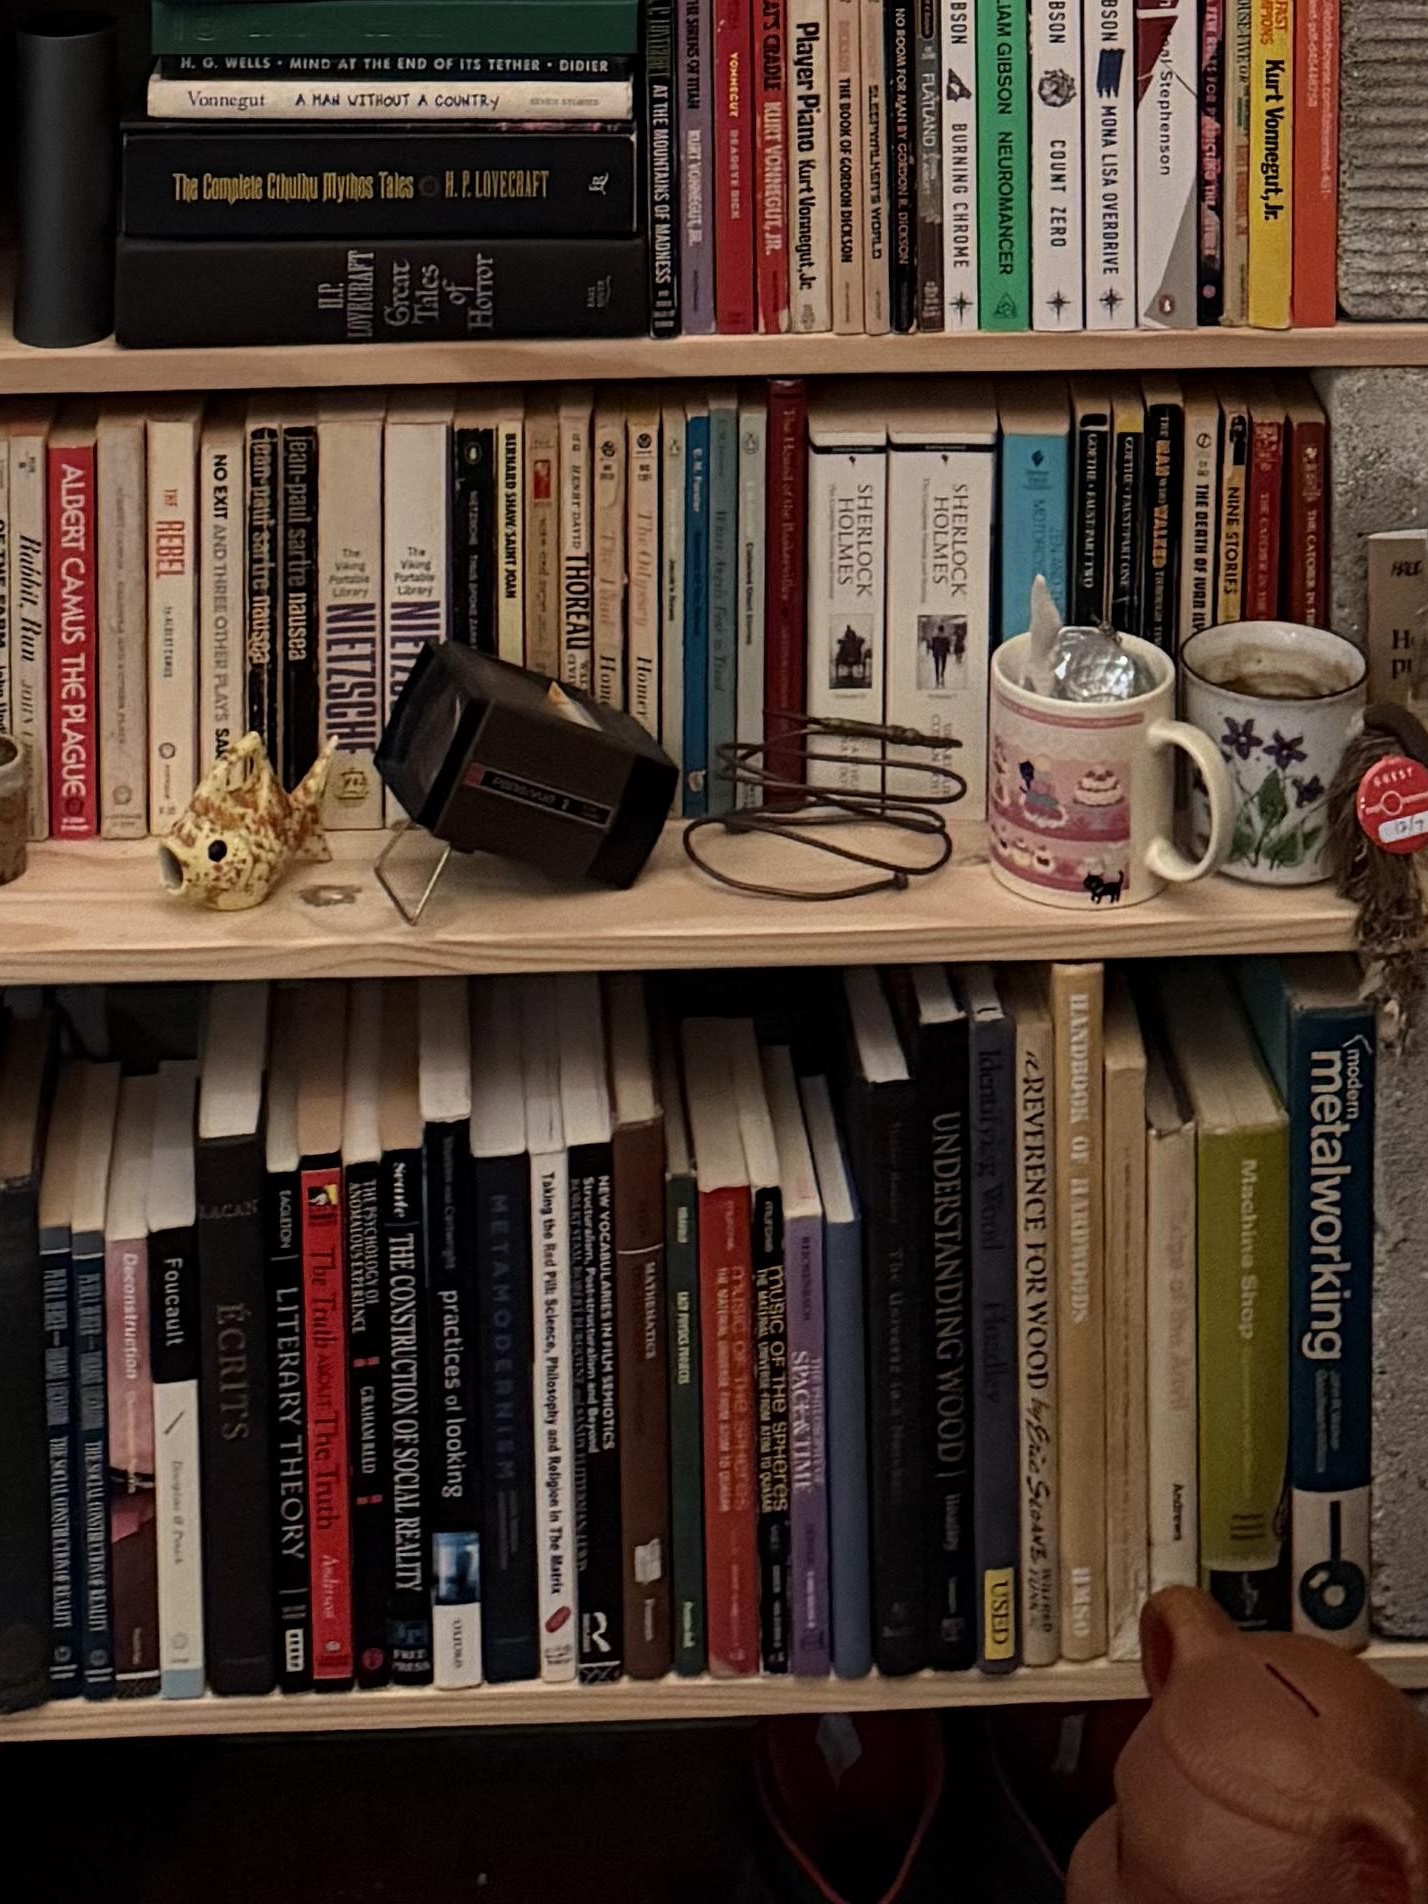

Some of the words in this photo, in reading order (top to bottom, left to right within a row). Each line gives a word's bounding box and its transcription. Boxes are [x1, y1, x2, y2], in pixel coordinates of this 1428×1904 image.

[188, 91, 265, 109] Vonnegut
[997, 132, 1012, 275] NEUROMANCER
[62, 464, 85, 551] ALBERT
[837, 499, 853, 588] HOLMES
[857, 483, 872, 598] SHERLOCK
[62, 557, 85, 645] CAMUS
[62, 653, 85, 690] THE
[62, 697, 85, 798] PLAGUE
[1345, 1048, 1361, 1120] modern
[1304, 1049, 1352, 1360] metalworking
[162, 1257, 184, 1346] Foucault
[276, 1289, 302, 1429] LITERARY
[280, 1436, 305, 1560] THEORY
[989, 1580, 1009, 1644] USED
